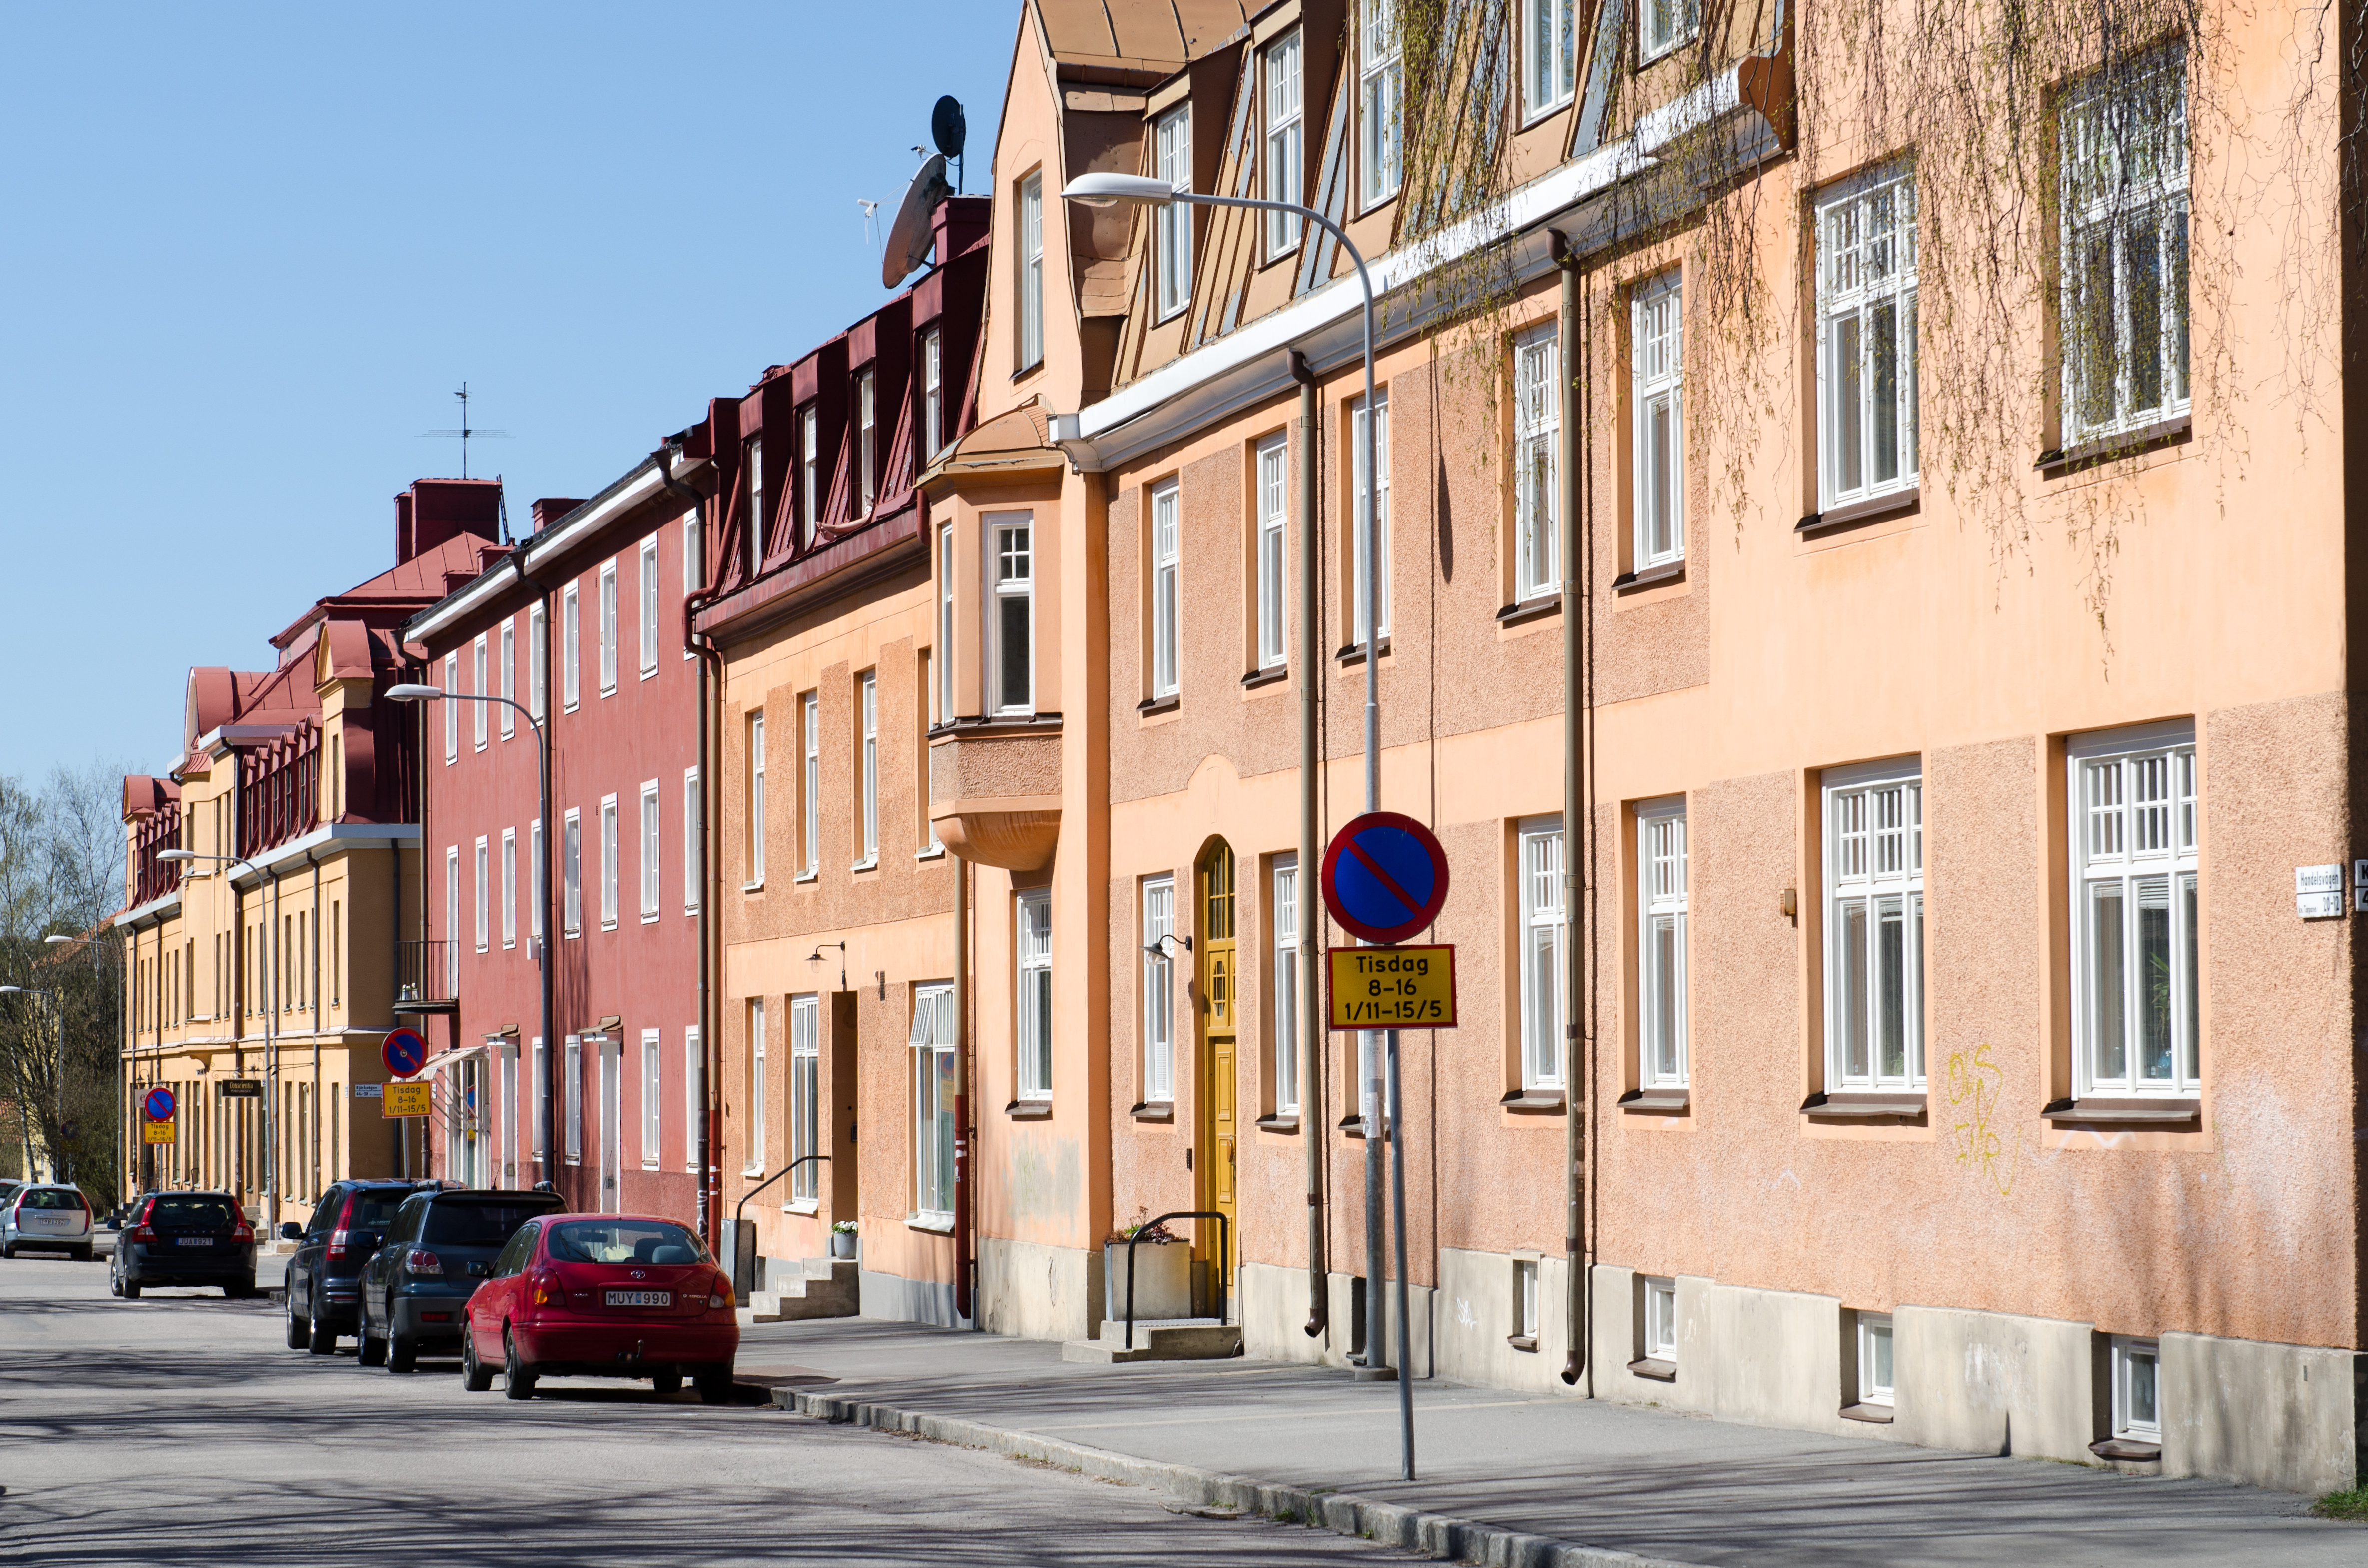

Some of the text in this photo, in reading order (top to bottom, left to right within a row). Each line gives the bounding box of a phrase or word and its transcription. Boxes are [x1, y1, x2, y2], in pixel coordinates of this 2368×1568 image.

[2301, 871, 2338, 889] Handelsvägen
[2323, 896, 2339, 912] 20-12
[1356, 955, 1429, 976] Tisdag
[1369, 978, 1417, 996] 8-16
[1345, 1000, 1442, 1021] 1/11-15/5
[393, 1086, 421, 1095] Tisdag
[389, 1104, 426, 1114] 1/11-15/5
[608, 1293, 668, 1304] MUY 990
